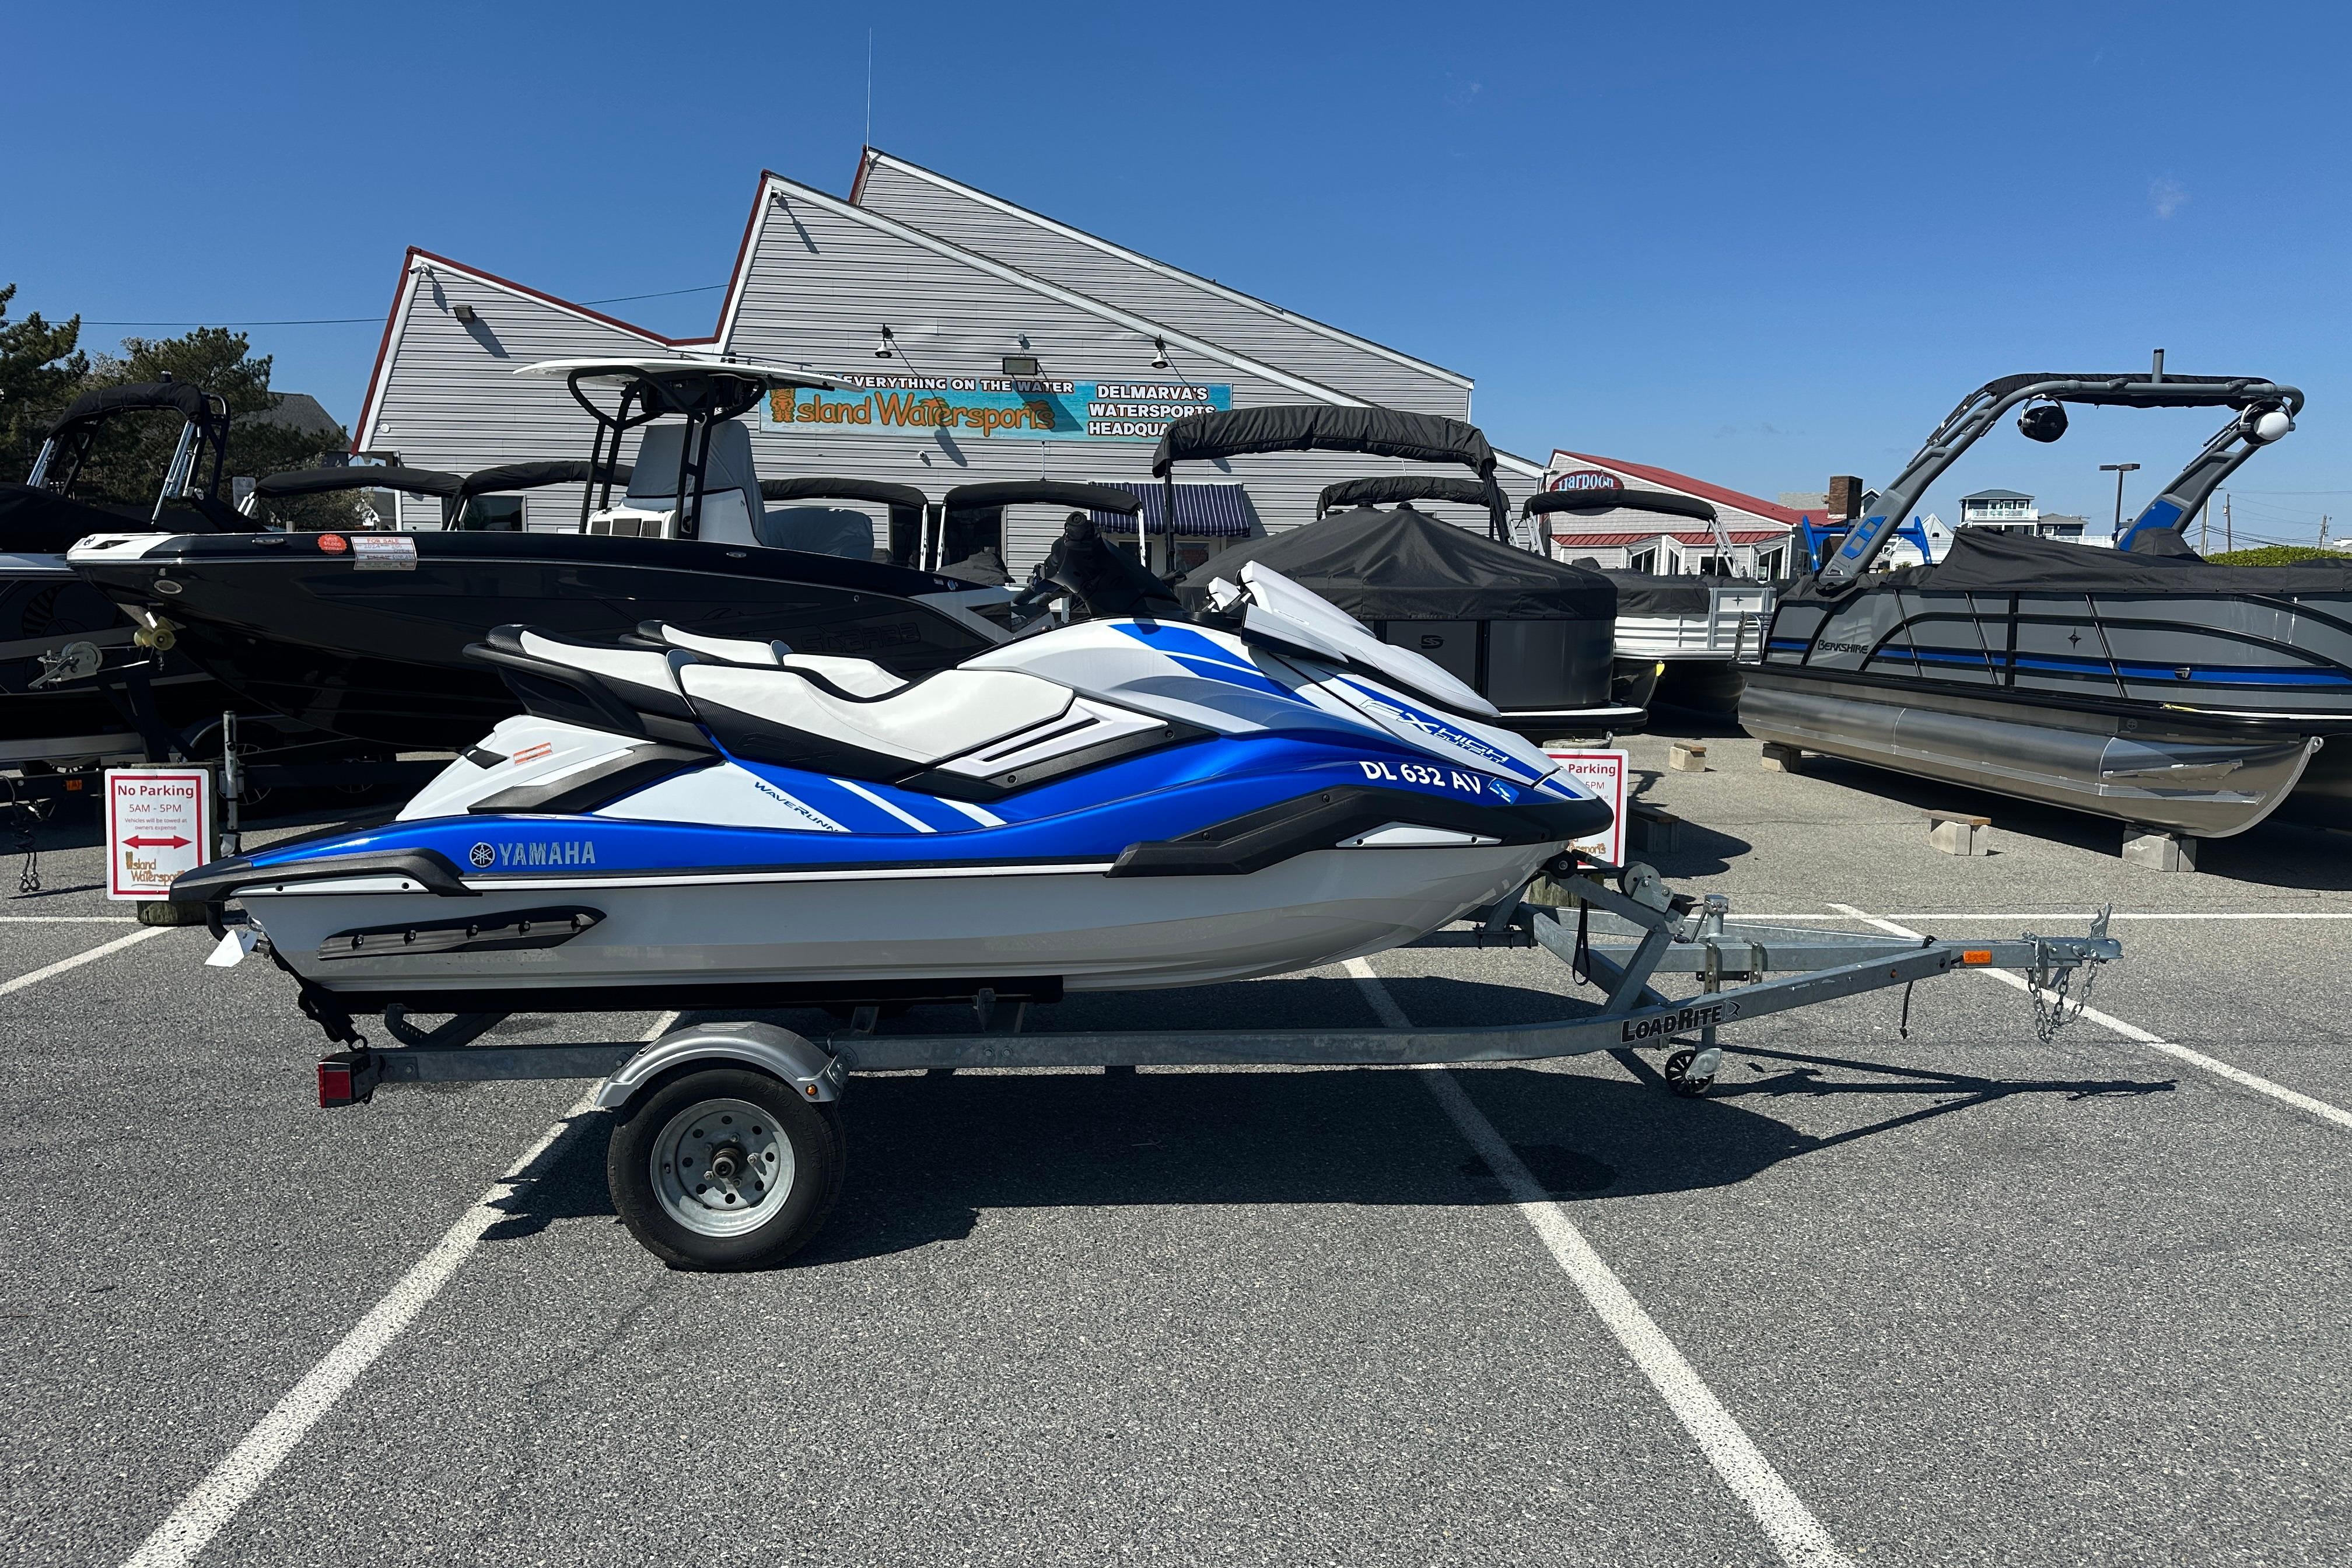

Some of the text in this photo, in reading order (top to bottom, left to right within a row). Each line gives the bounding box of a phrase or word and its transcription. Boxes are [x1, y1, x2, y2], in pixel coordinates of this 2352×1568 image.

[843, 376, 947, 391] EVERYTHING
[951, 379, 975, 391] ON
[981, 380, 1012, 391] THE
[1017, 381, 1074, 393] WATER
[1097, 385, 1208, 400] DELMARVA'S
[874, 391, 1055, 437] Watersports
[1088, 421, 1168, 437] HEADQUA
[1818, 639, 1869, 654] BERKSHIRE
[1434, 732, 1504, 764] OUTPUT
[1438, 727, 1510, 762] HIGH
[1359, 761, 1481, 794] DL 632 AV
[1569, 764, 1616, 776] Parking
[118, 785, 194, 799] No Parking
[1585, 781, 1604, 789] 5PM
[129, 804, 150, 813] 5AM
[160, 804, 182, 813] 5PM
[755, 782, 839, 832] WAVERUNN
[125, 850, 156, 870] Island
[498, 841, 596, 866] YAMAHA
